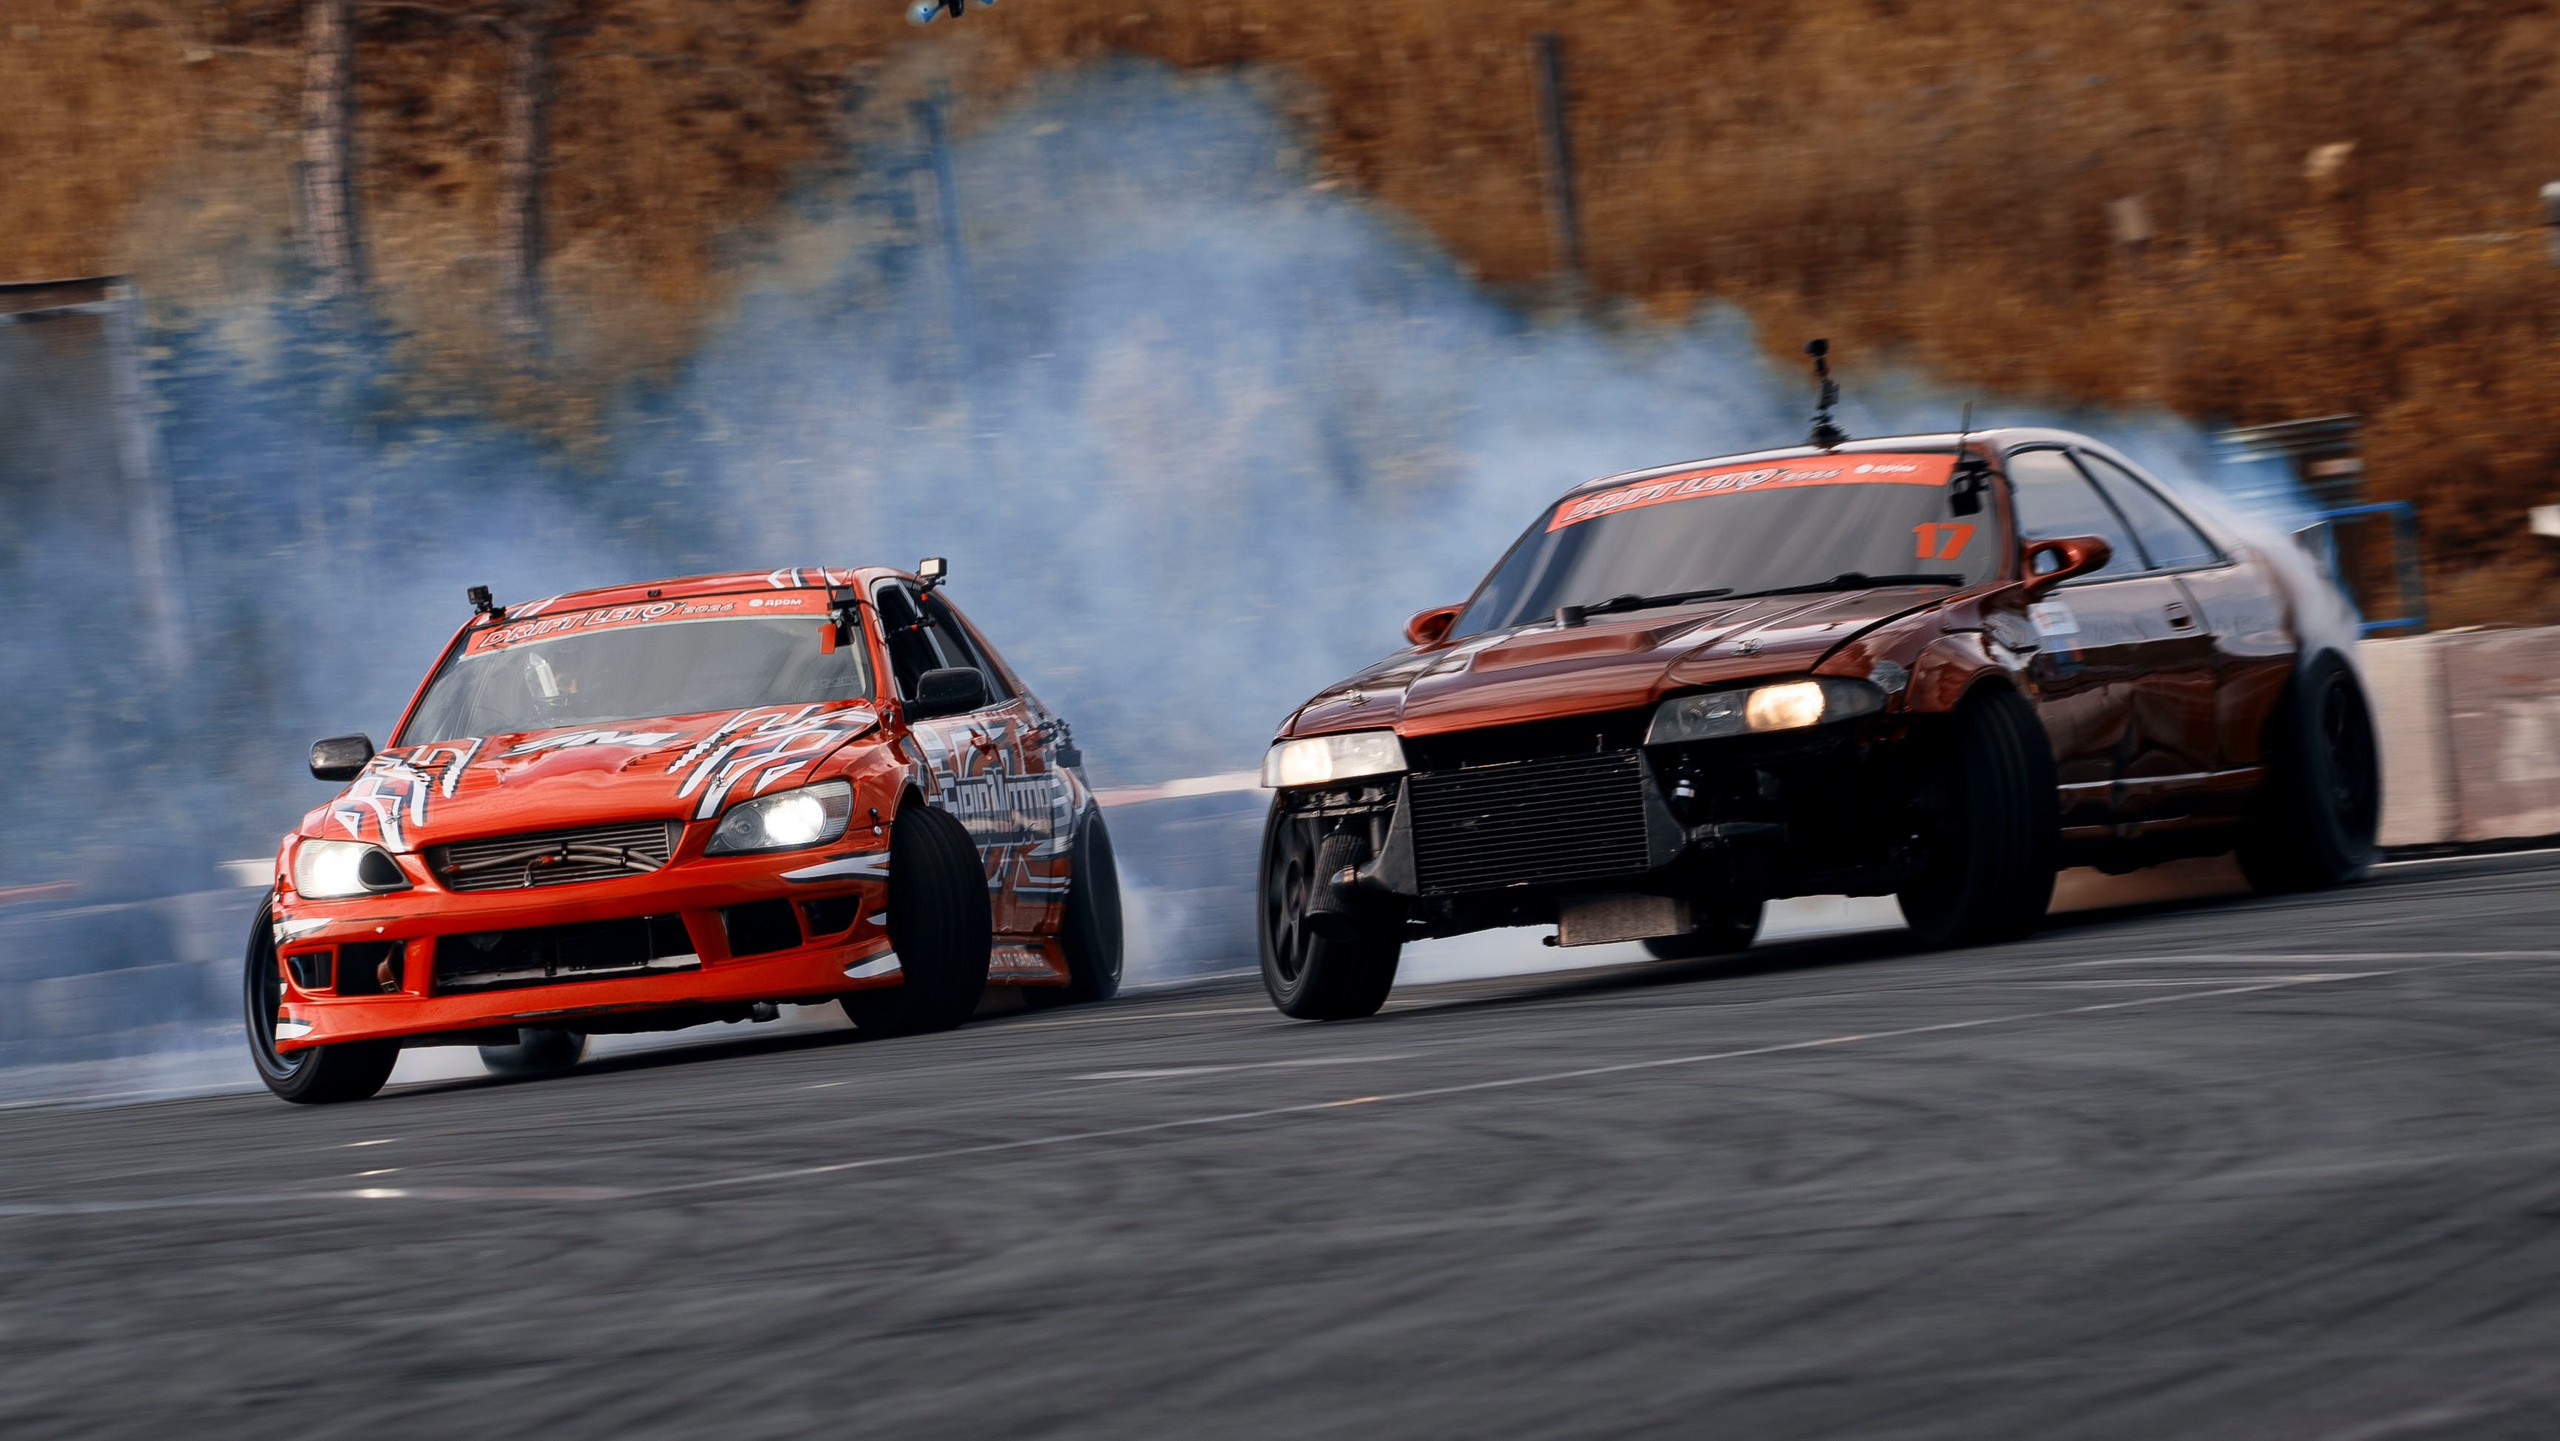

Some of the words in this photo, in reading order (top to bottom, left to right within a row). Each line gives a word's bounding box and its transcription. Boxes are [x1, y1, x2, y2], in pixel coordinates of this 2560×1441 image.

[1561, 480, 1684, 522] DRIFT
[1673, 468, 1779, 496] LETO
[1912, 522, 1976, 560] 17
[764, 598, 802, 607] дром
[479, 613, 586, 648] DRIFT
[584, 601, 676, 627] LETO
[817, 623, 837, 654] 1
